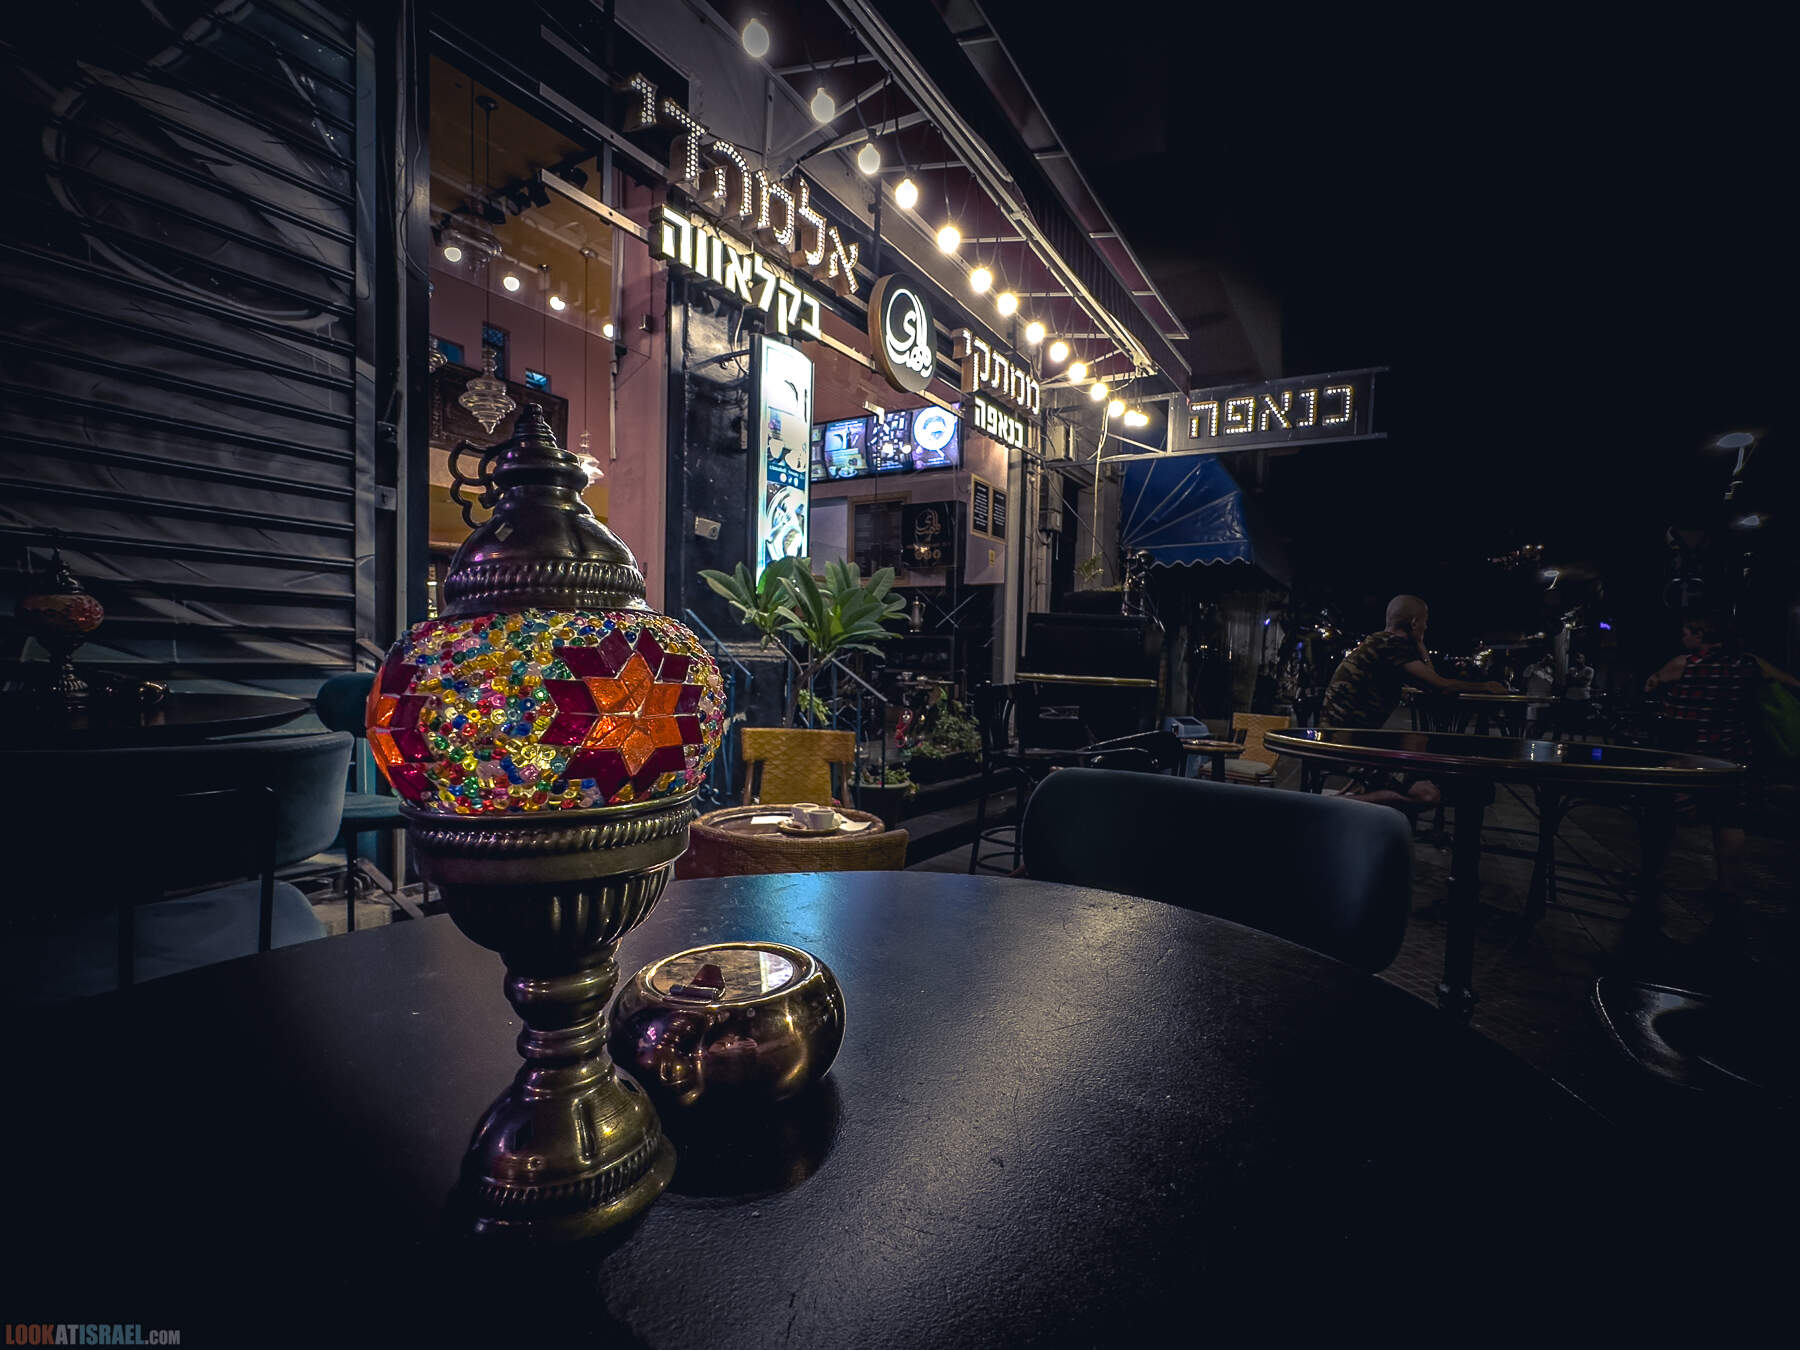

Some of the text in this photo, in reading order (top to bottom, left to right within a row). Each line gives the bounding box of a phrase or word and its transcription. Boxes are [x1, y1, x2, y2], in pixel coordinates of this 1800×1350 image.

[630, 73, 859, 294] אלמהדי
[661, 206, 821, 340] בקלאווה
[961, 328, 1041, 416] ממתקי
[1188, 384, 1353, 439] כנאפה
[973, 396, 1024, 449] כנאפה
